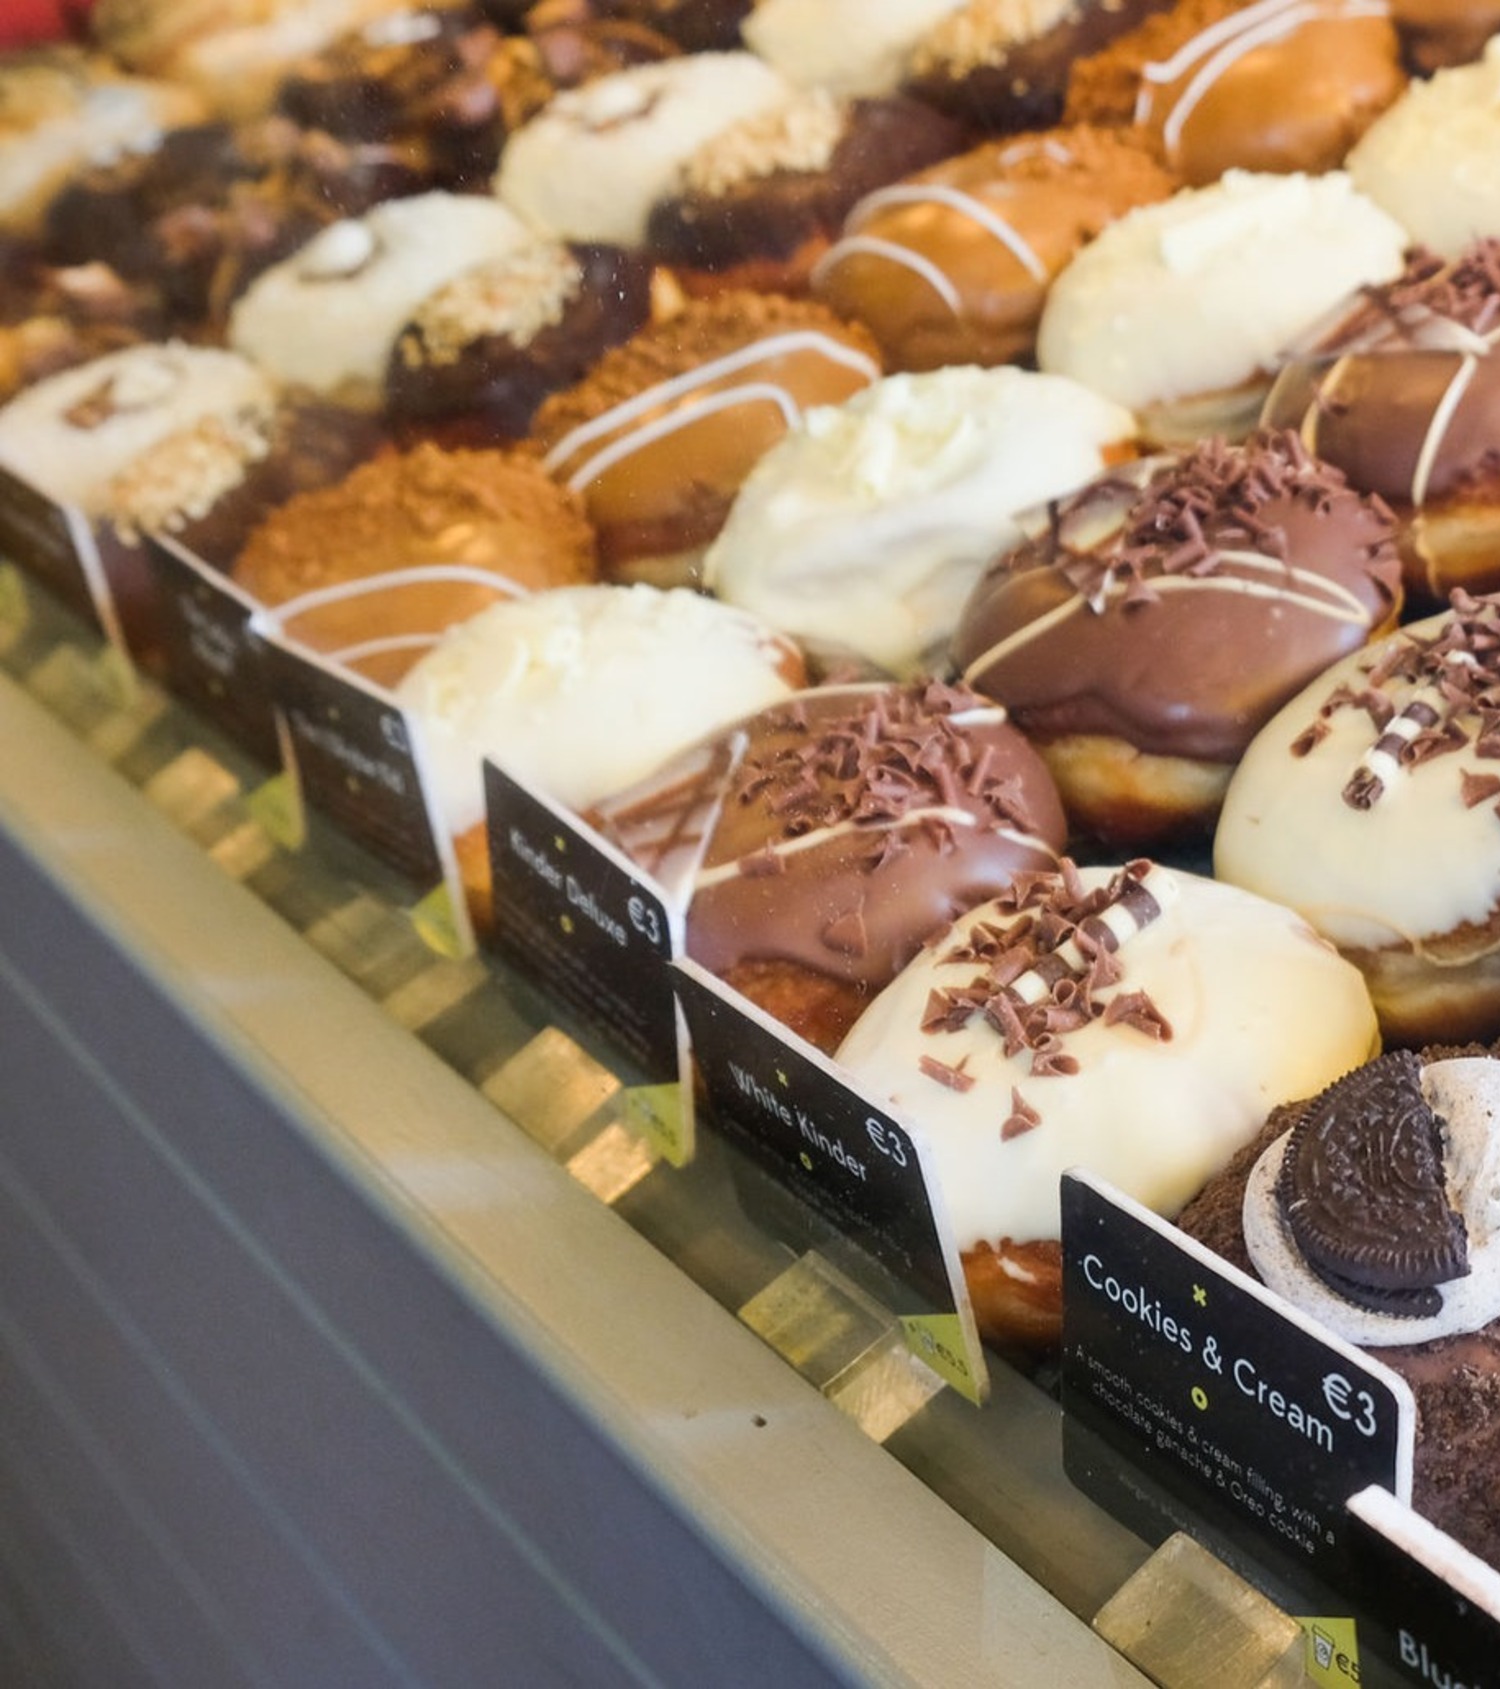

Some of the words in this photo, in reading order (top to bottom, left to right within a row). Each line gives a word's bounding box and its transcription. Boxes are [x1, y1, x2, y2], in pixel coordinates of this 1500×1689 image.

[509, 827, 563, 890] Kinder
[565, 873, 629, 947] Deluxe
[627, 896, 661, 944] €3
[728, 1060, 794, 1127] White
[797, 1113, 868, 1182] Kinder
[865, 1117, 908, 1169] €3
[1083, 1254, 1193, 1353] Cookies
[1202, 1336, 1223, 1375] &
[1234, 1359, 1334, 1453] Cream
[1322, 1373, 1377, 1437] €3
[1088, 1356, 1132, 1394] smooth
[1136, 1392, 1183, 1434] cookies
[1187, 1425, 1199, 1444] &
[1202, 1440, 1243, 1475] cream
[1291, 1504, 1321, 1535] with
[1325, 1530, 1336, 1547] a
[1092, 1382, 1153, 1434] chocolate
[1156, 1428, 1212, 1478] ganache
[1215, 1470, 1226, 1488] &
[1230, 1481, 1265, 1517] Oreo
[1268, 1512, 1316, 1554] cookie
